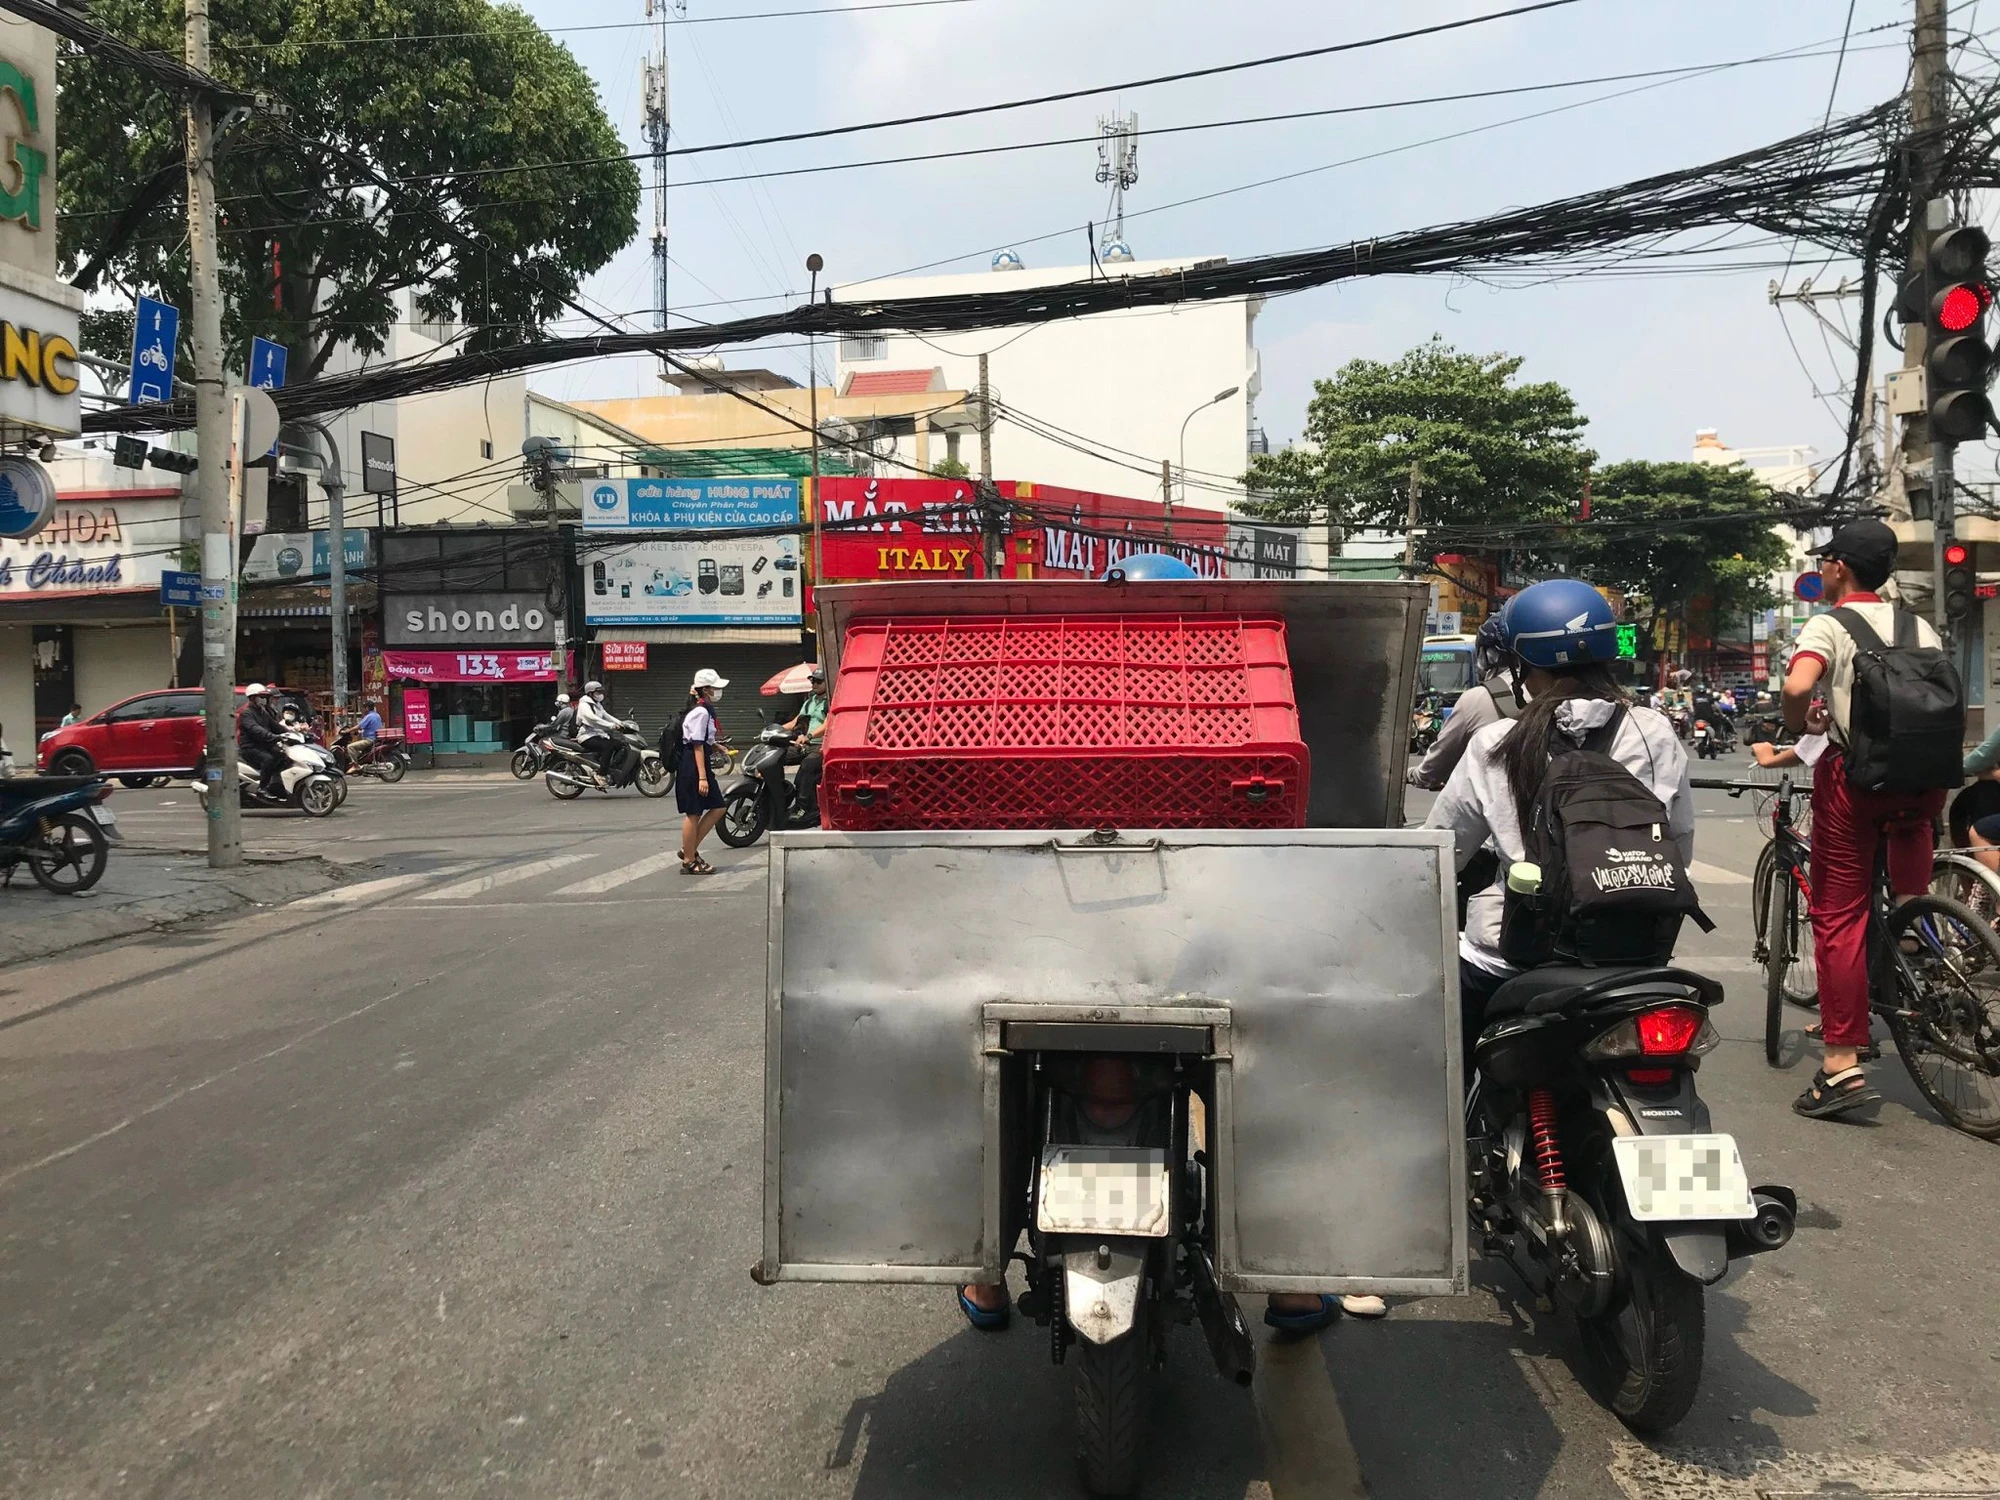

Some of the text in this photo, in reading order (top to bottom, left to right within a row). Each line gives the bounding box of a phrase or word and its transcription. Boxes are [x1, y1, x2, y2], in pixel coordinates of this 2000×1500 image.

[0, 320, 79, 395] NC
[367, 457, 395, 472] shondo
[752, 484, 792, 499] PHÁT
[824, 479, 907, 532] MẮT
[631, 509, 794, 525] KHÓA & PHỤ KIỆN CỬA CAO CẤP
[19, 508, 121, 544] HOA
[733, 543, 765, 551] VESPA
[877, 548, 970, 570] ITALY
[1171, 542, 1226, 579] TALY
[406, 604, 544, 632] shondo
[1567, 627, 1594, 635] HONDA
[605, 643, 645, 654] Sửa khóa
[418, 665, 434, 674] GIÁ
